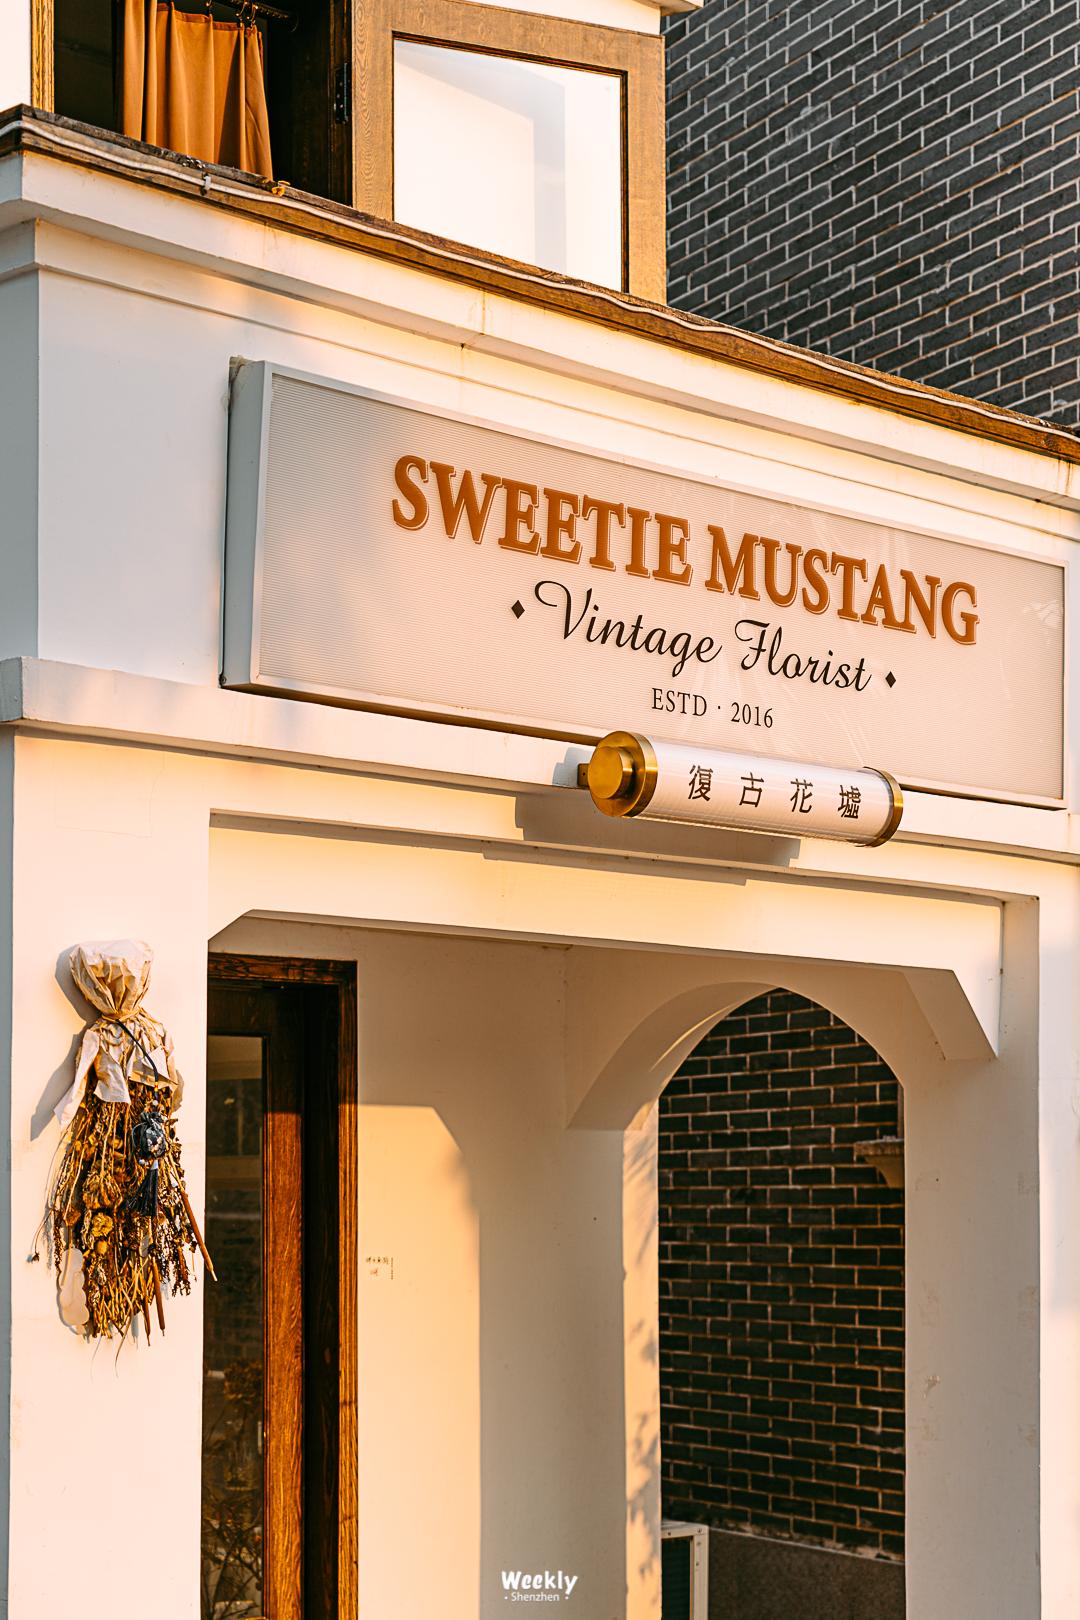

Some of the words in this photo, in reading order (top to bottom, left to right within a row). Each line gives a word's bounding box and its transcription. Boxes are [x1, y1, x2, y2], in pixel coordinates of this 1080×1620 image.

[392, 455, 693, 586] SWEETIE
[705, 524, 980, 645] MUSTANG
[534, 580, 723, 677] Vintage
[734, 619, 872, 692] Florist
[651, 687, 708, 717] ESTD
[730, 701, 774, 729] 2016
